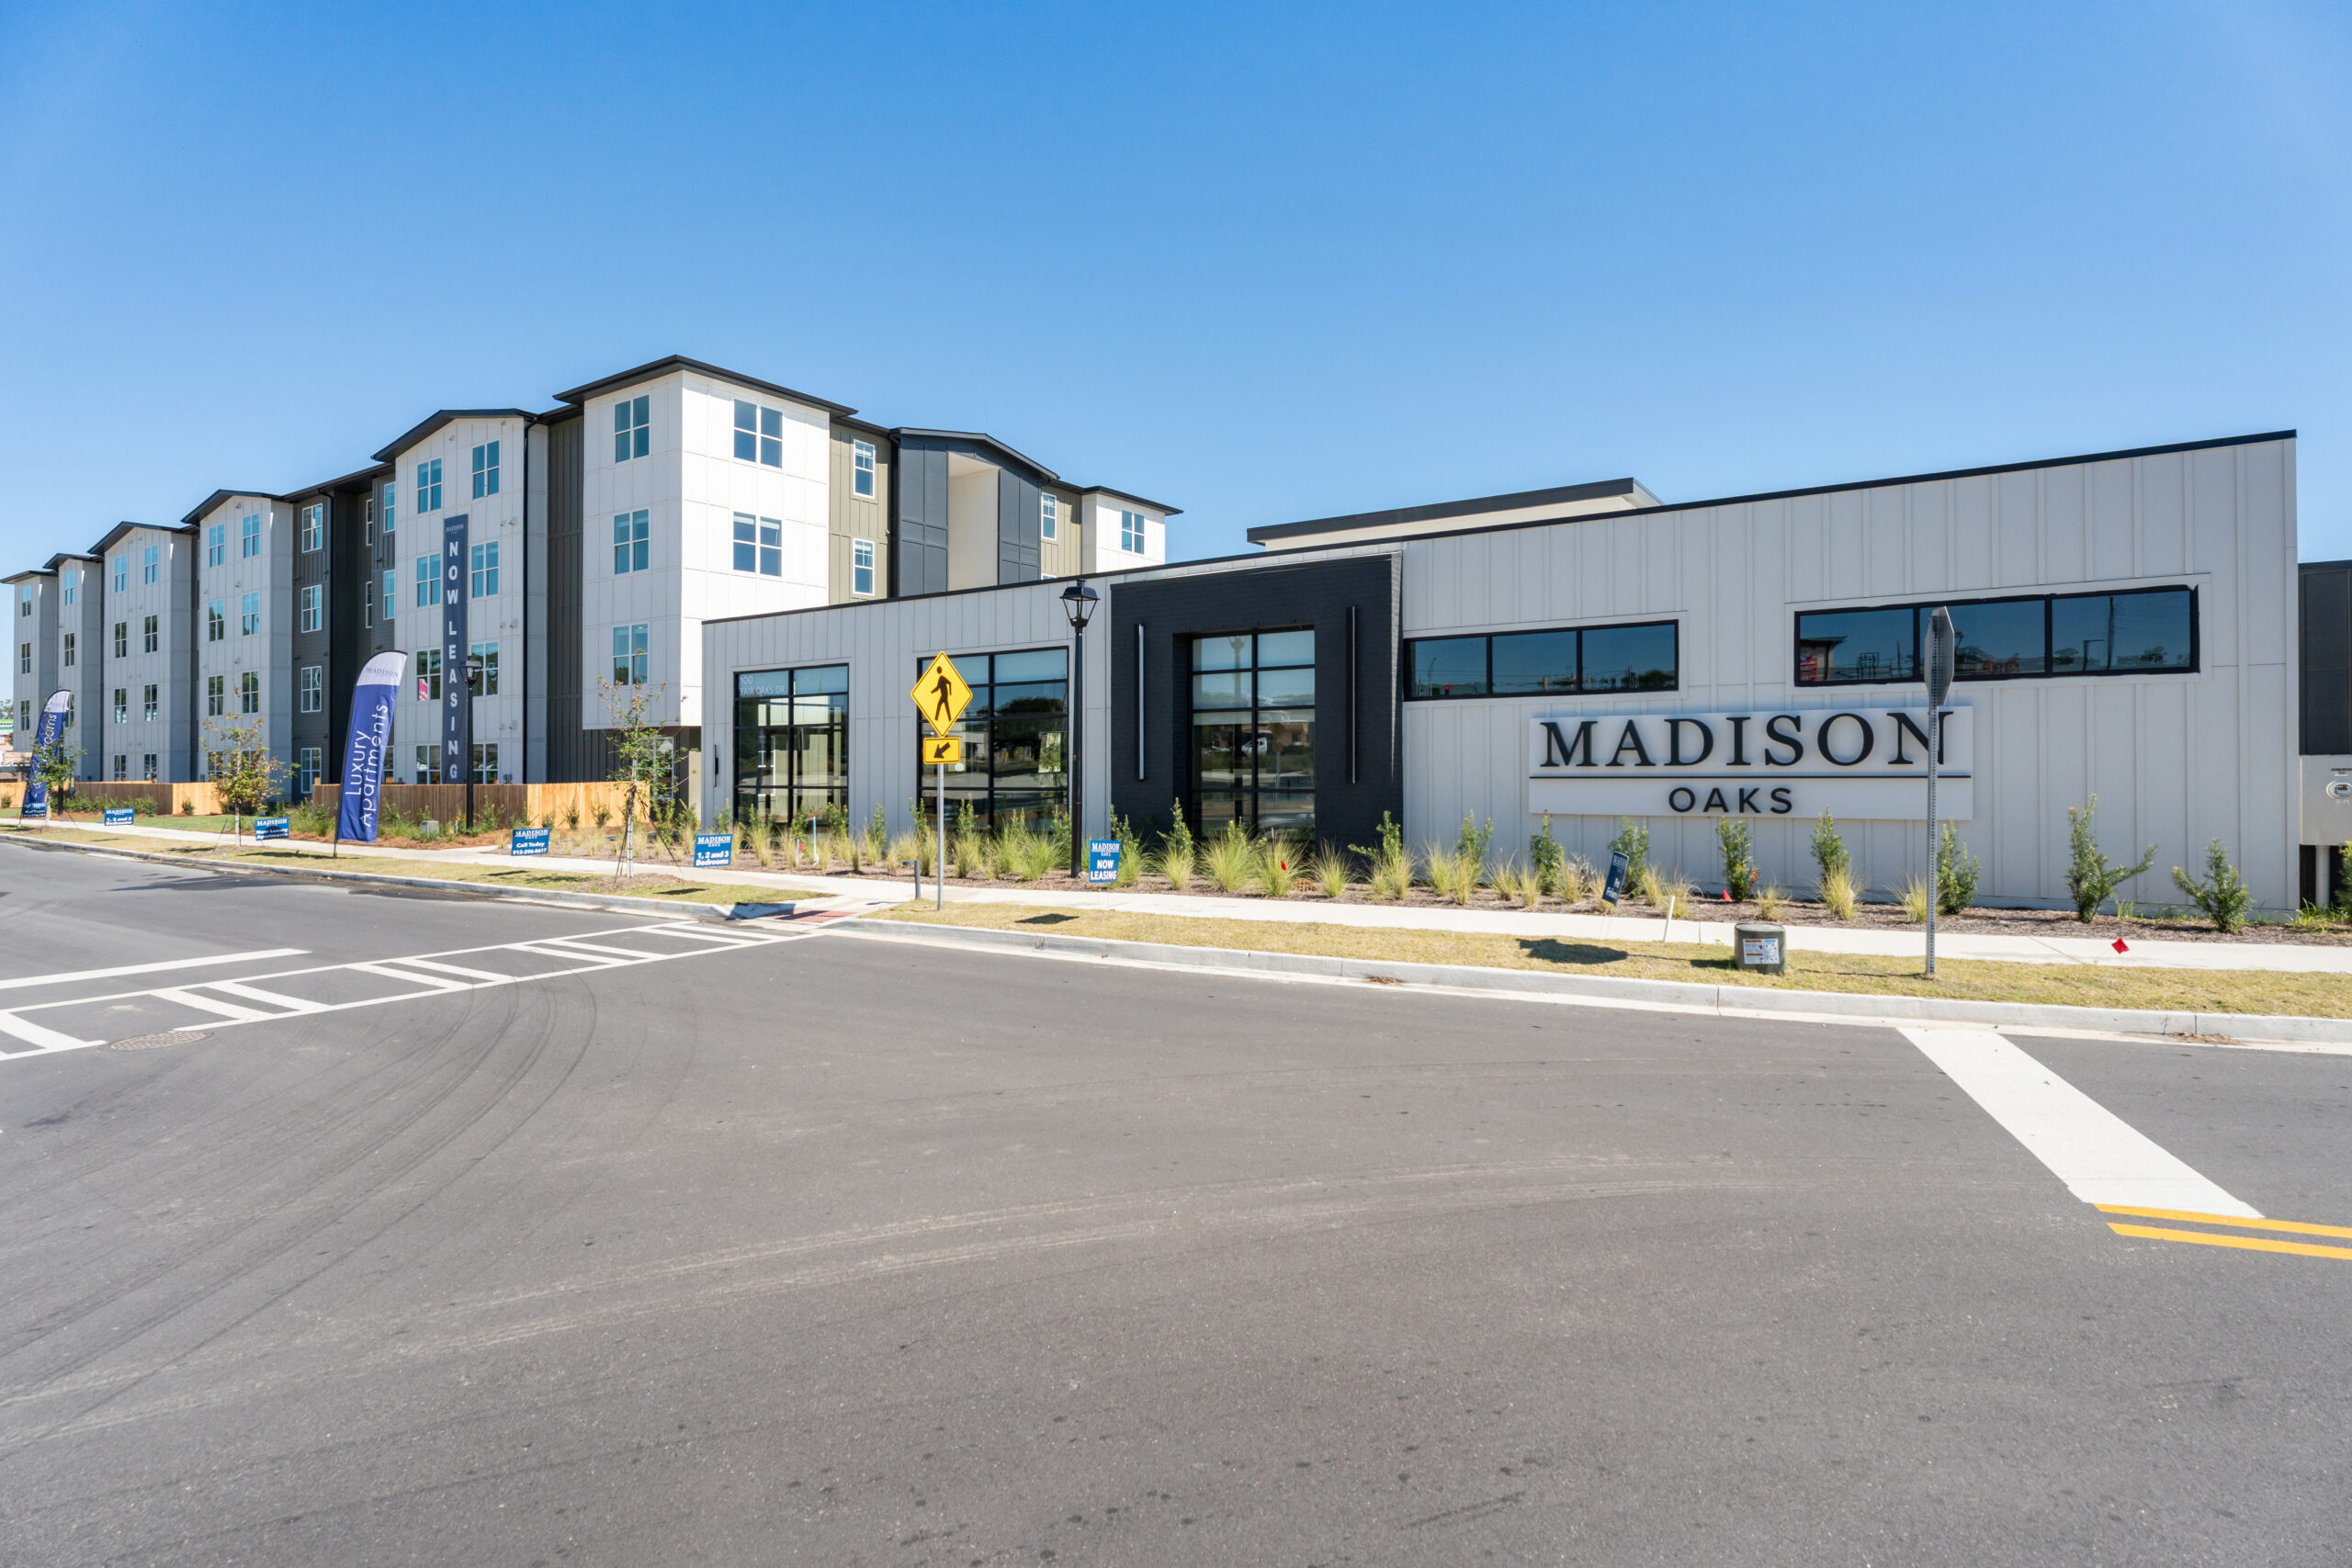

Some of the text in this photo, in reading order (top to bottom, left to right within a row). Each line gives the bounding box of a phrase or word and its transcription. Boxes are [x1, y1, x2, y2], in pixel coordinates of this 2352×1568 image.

[447, 540, 459, 604] NOW
[740, 675, 753, 684] 100
[740, 687, 754, 695] FAIR
[755, 686, 774, 695] OAKS
[447, 620, 459, 780] LEASING
[1539, 711, 1954, 767] MADISON
[345, 730, 371, 795] Luxury
[359, 705, 389, 828] Apartments
[1668, 786, 1794, 814] OAKS
[515, 829, 548, 838] MADISON
[1091, 842, 1120, 851] MADISON
[711, 851, 724, 859] and
[1096, 859, 1114, 870] NOW
[1090, 870, 1117, 880] LEASING
